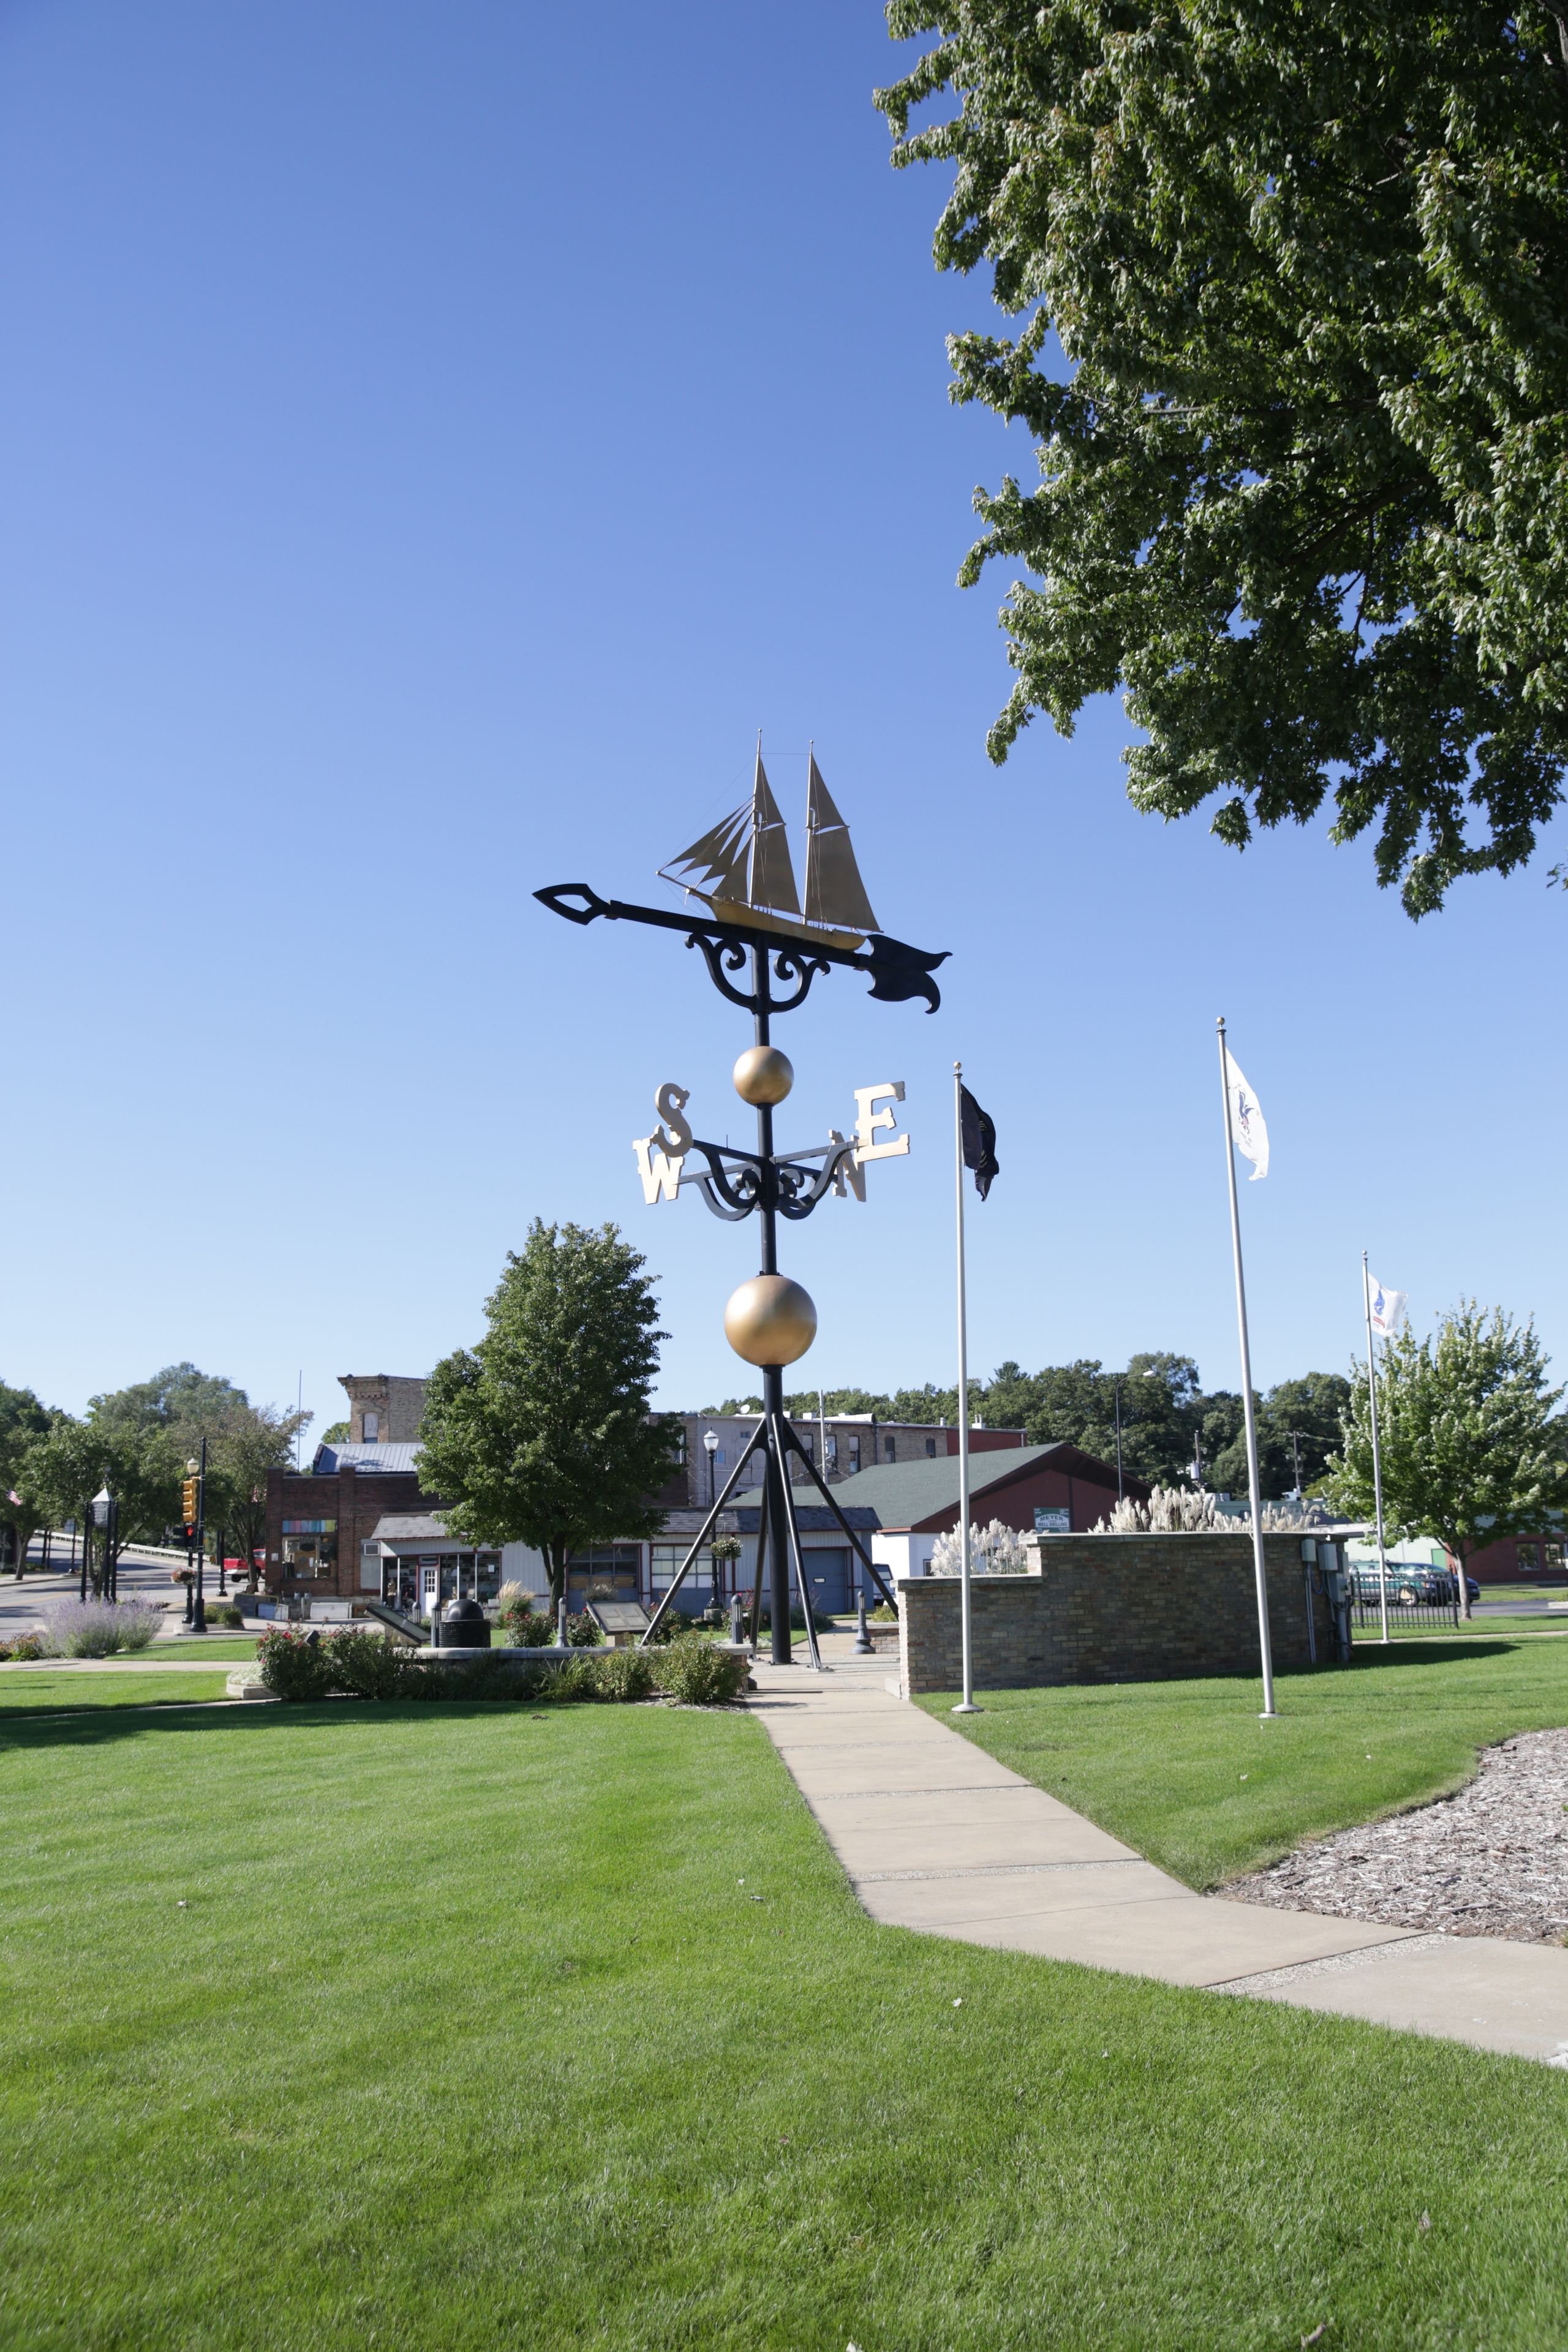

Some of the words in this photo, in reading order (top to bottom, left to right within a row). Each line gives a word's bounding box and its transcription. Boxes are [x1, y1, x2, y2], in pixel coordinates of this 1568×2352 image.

[650, 1083, 694, 1158] S
[854, 1080, 910, 1163] E
[632, 1137, 685, 1205] W
[828, 1129, 867, 1202] N
